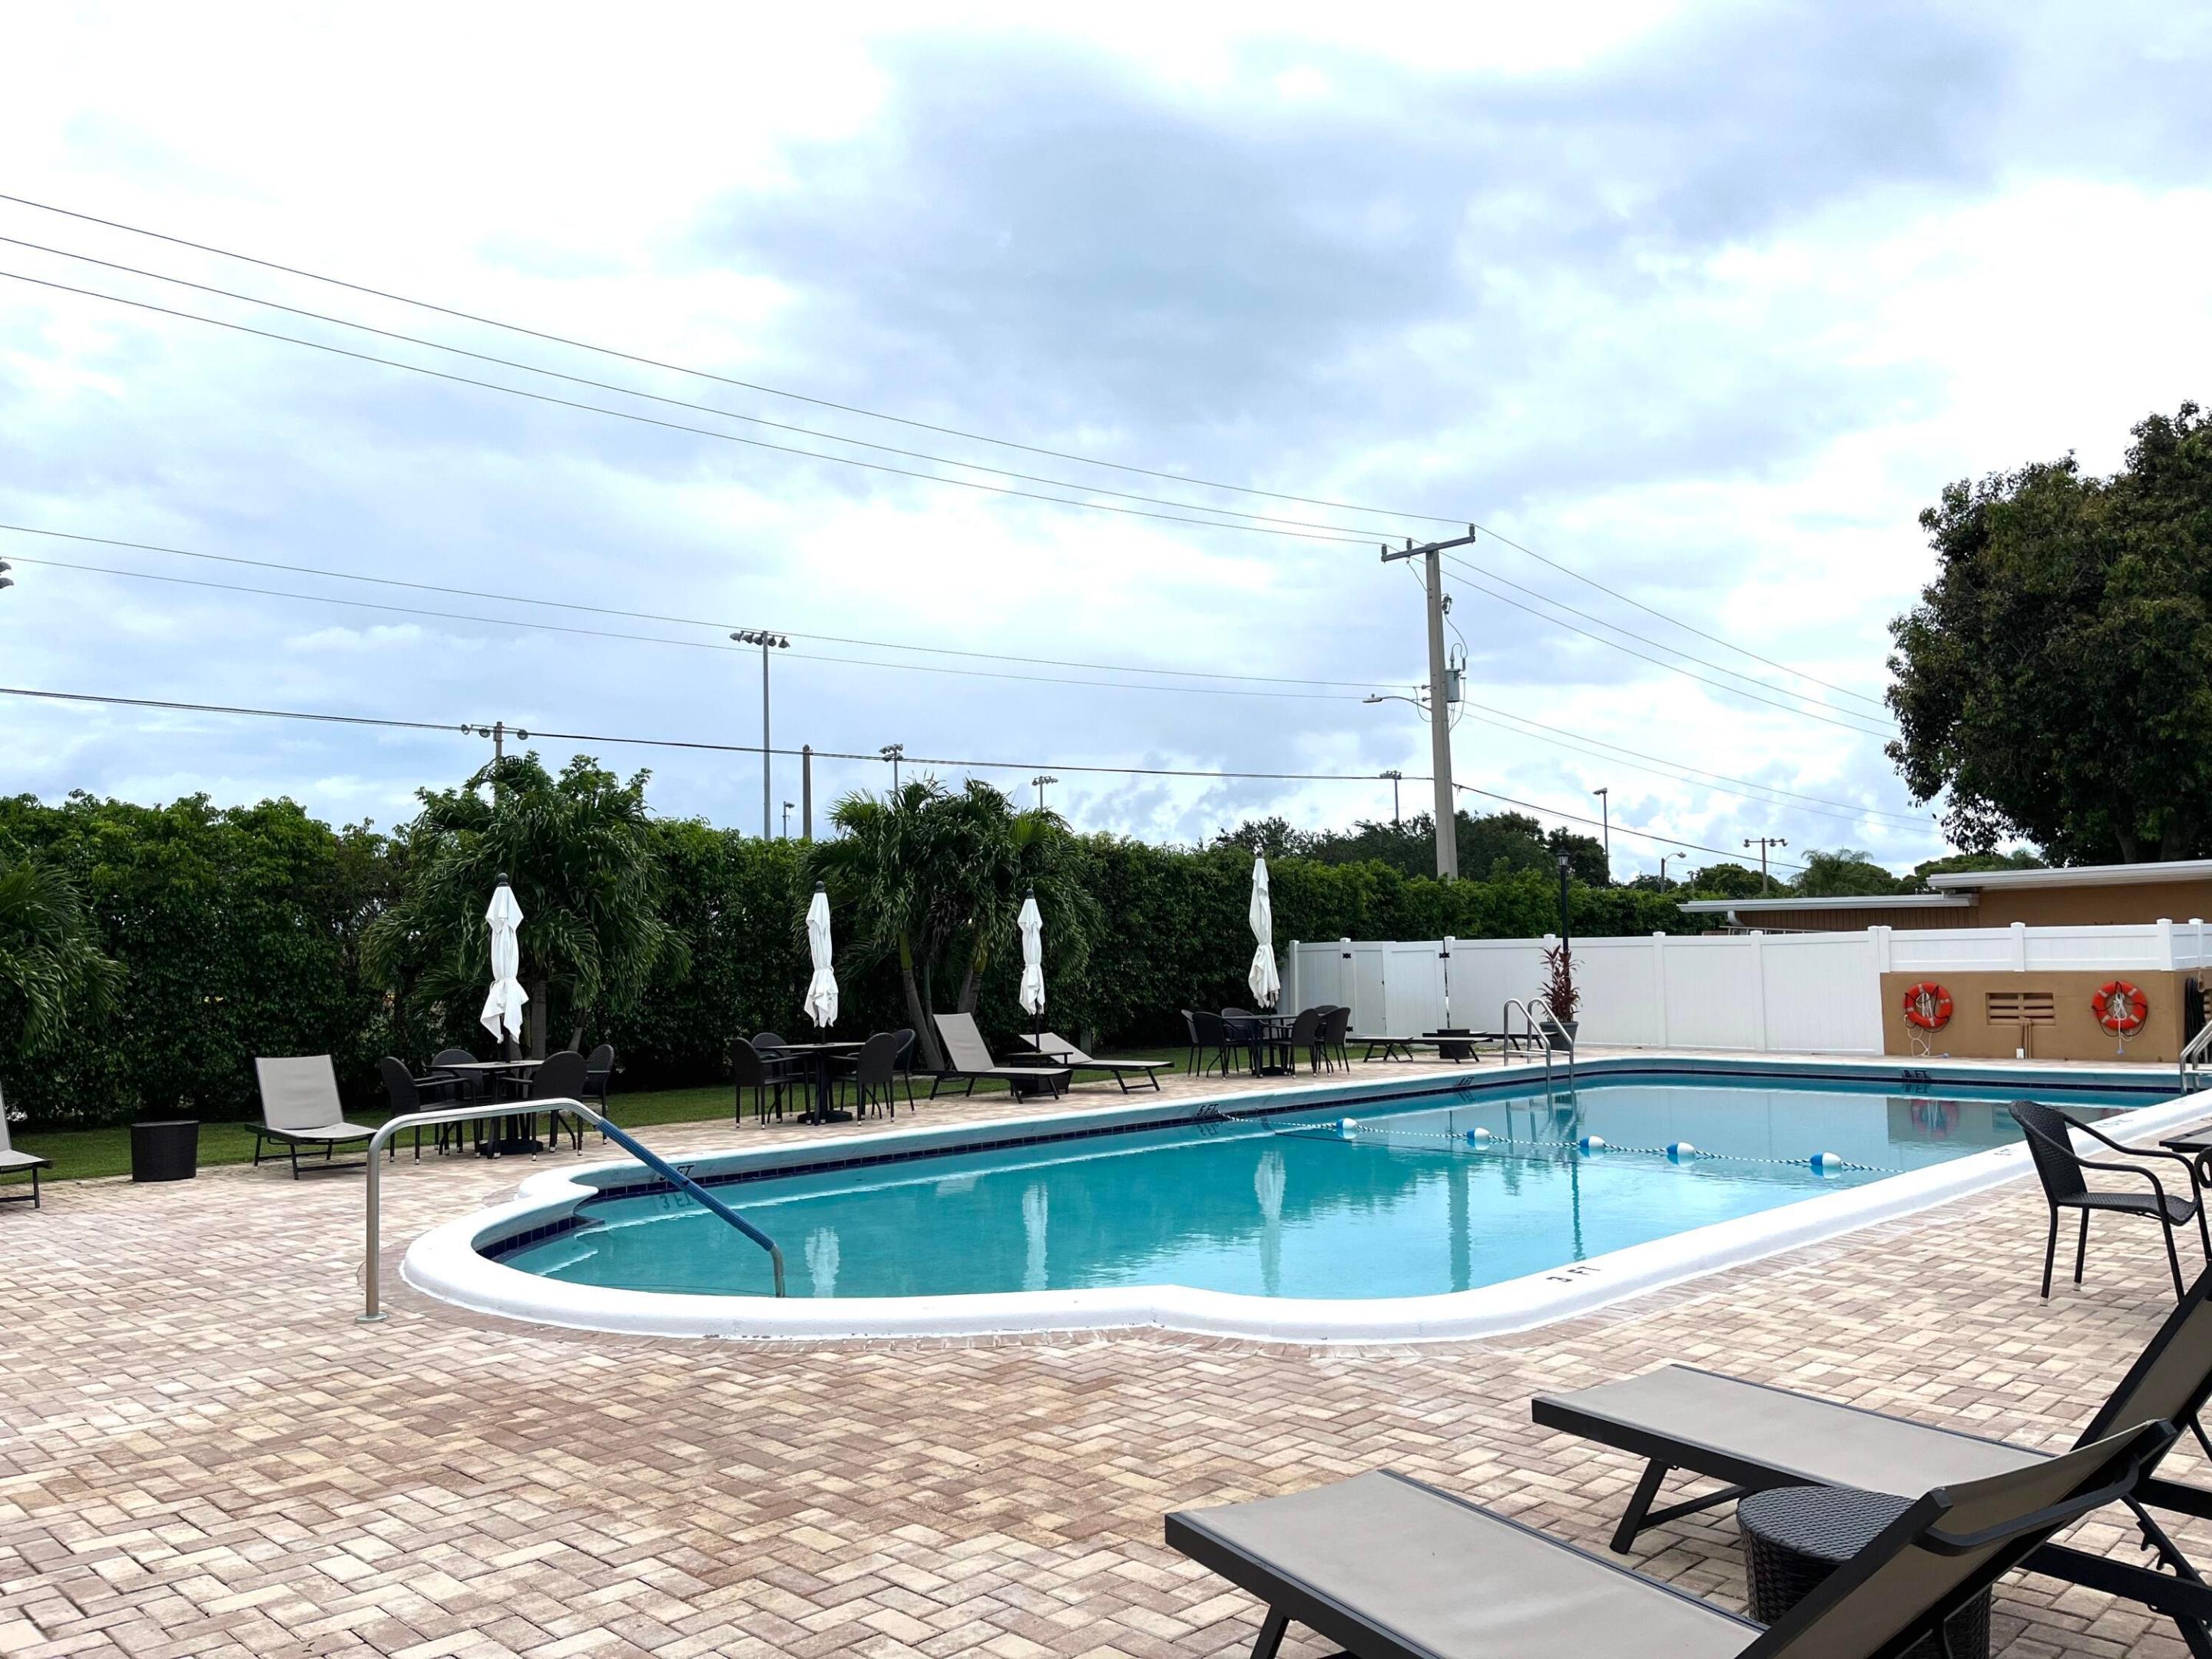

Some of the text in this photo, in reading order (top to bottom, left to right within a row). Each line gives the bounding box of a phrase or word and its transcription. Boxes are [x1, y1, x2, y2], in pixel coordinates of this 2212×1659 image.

[1915, 1070, 1928, 1078] FT
[1197, 1104, 1219, 1115] 5 FT
[1567, 1266, 1601, 1276] FT
